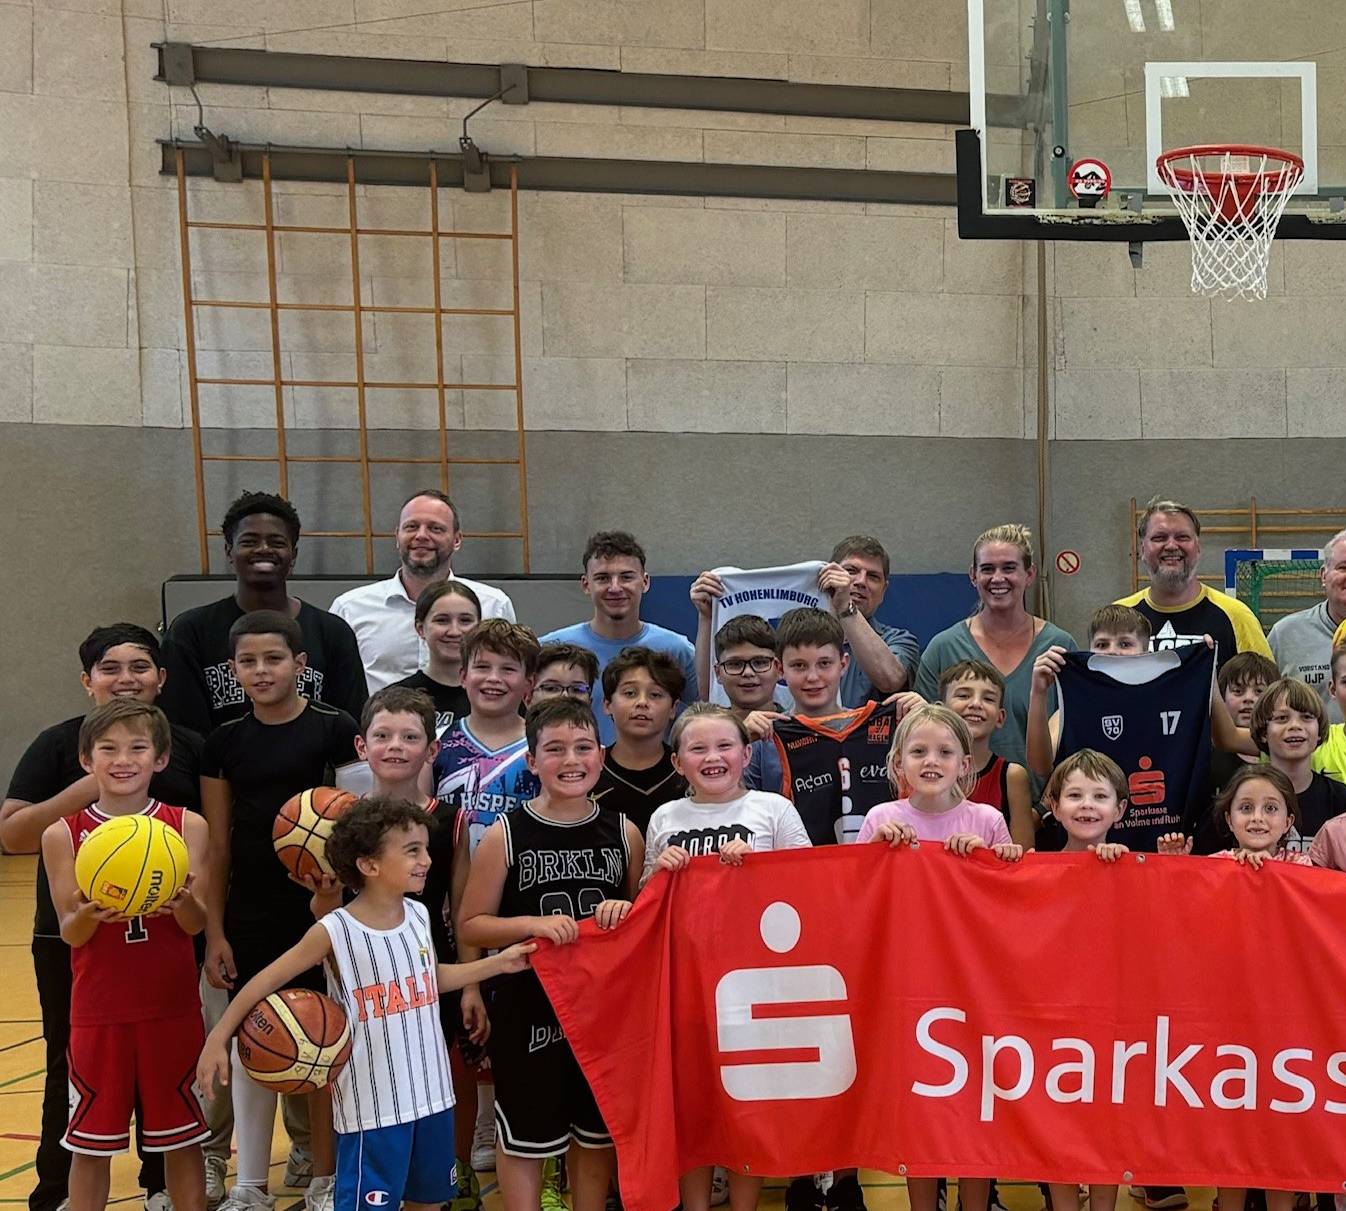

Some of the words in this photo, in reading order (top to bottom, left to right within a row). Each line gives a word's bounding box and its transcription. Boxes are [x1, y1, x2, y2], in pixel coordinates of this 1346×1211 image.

[720, 596, 734, 608] TV
[735, 588, 819, 608] HOHENLIMBURG
[1305, 673, 1324, 684] UJP
[1160, 710, 1181, 735] 17
[1106, 727, 1120, 735] 70
[1165, 814, 1181, 824] Ruh
[518, 848, 623, 891] BRKLN
